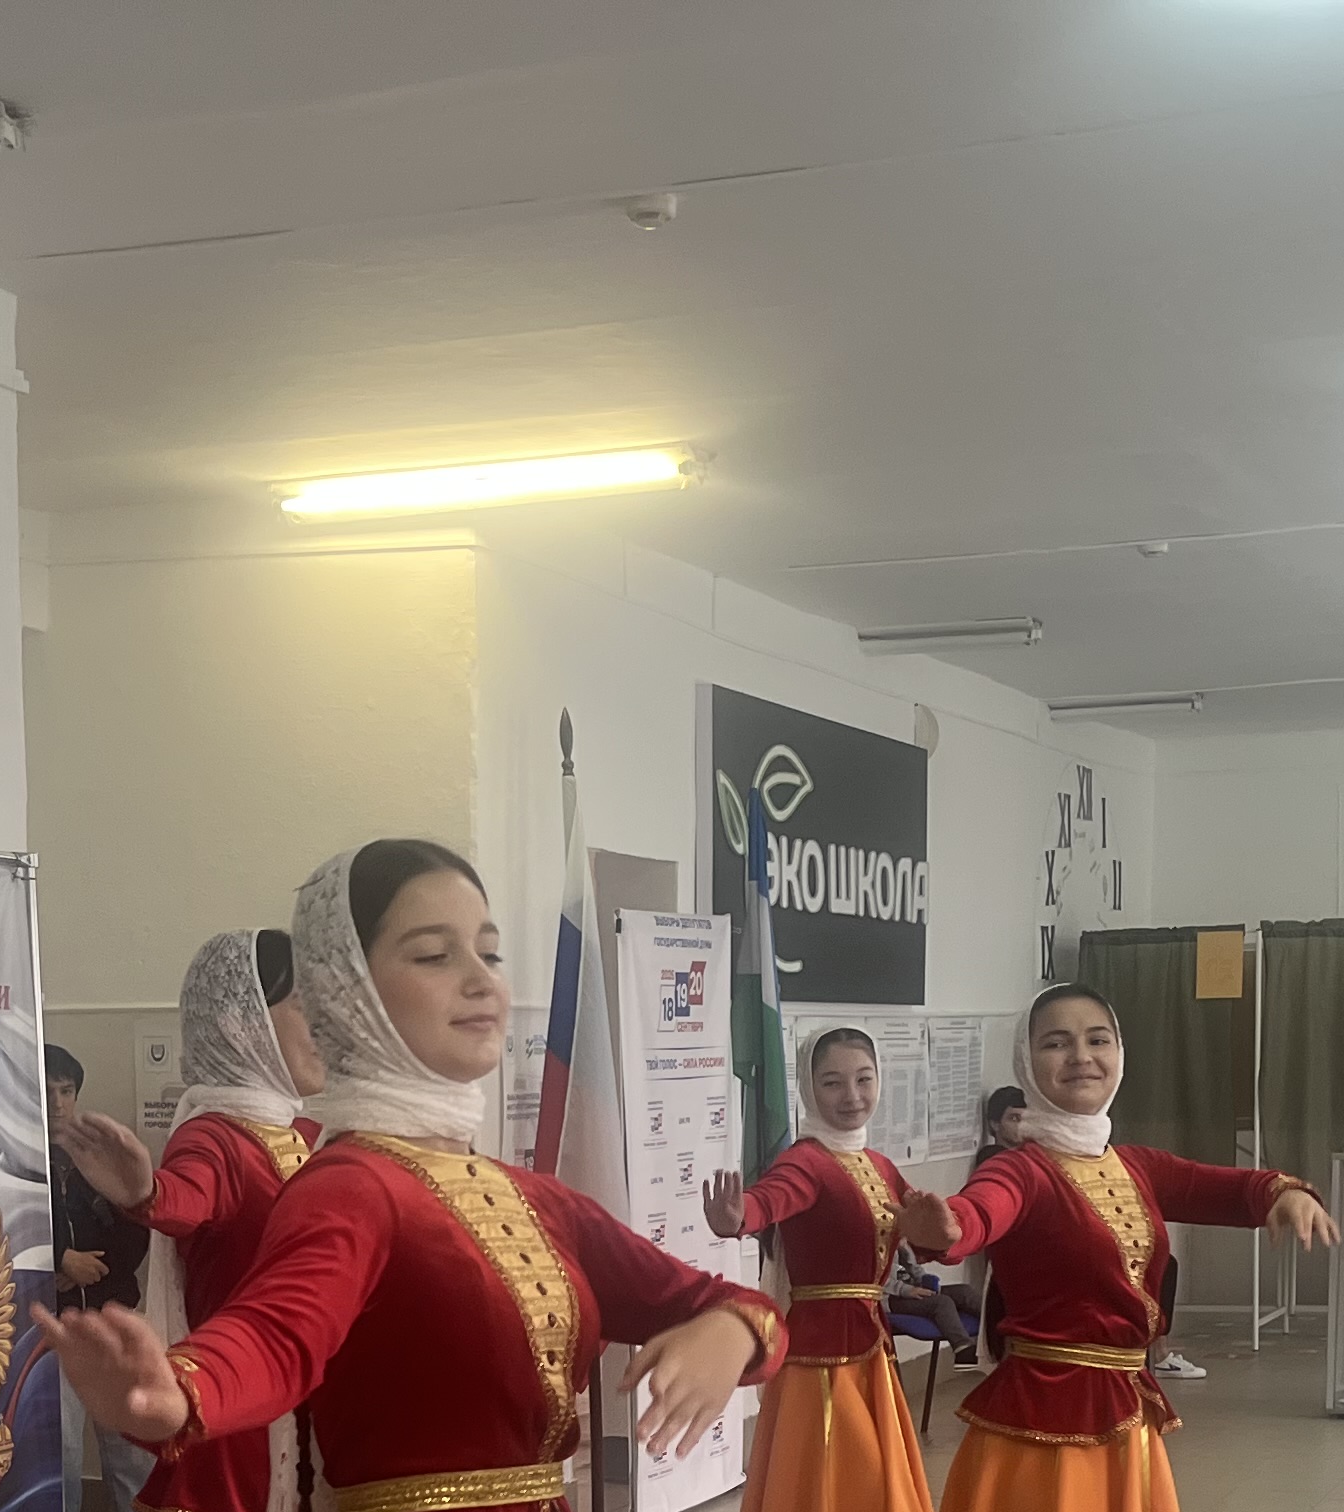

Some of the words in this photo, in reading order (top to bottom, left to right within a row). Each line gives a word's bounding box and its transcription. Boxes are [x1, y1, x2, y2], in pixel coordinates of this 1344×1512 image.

[662, 998, 674, 1021] 18
[676, 983, 688, 1008] 19
[689, 971, 703, 996] 20
[144, 1111, 175, 1119] МЕСТНО
[144, 1121, 172, 1129] ГОРОД
